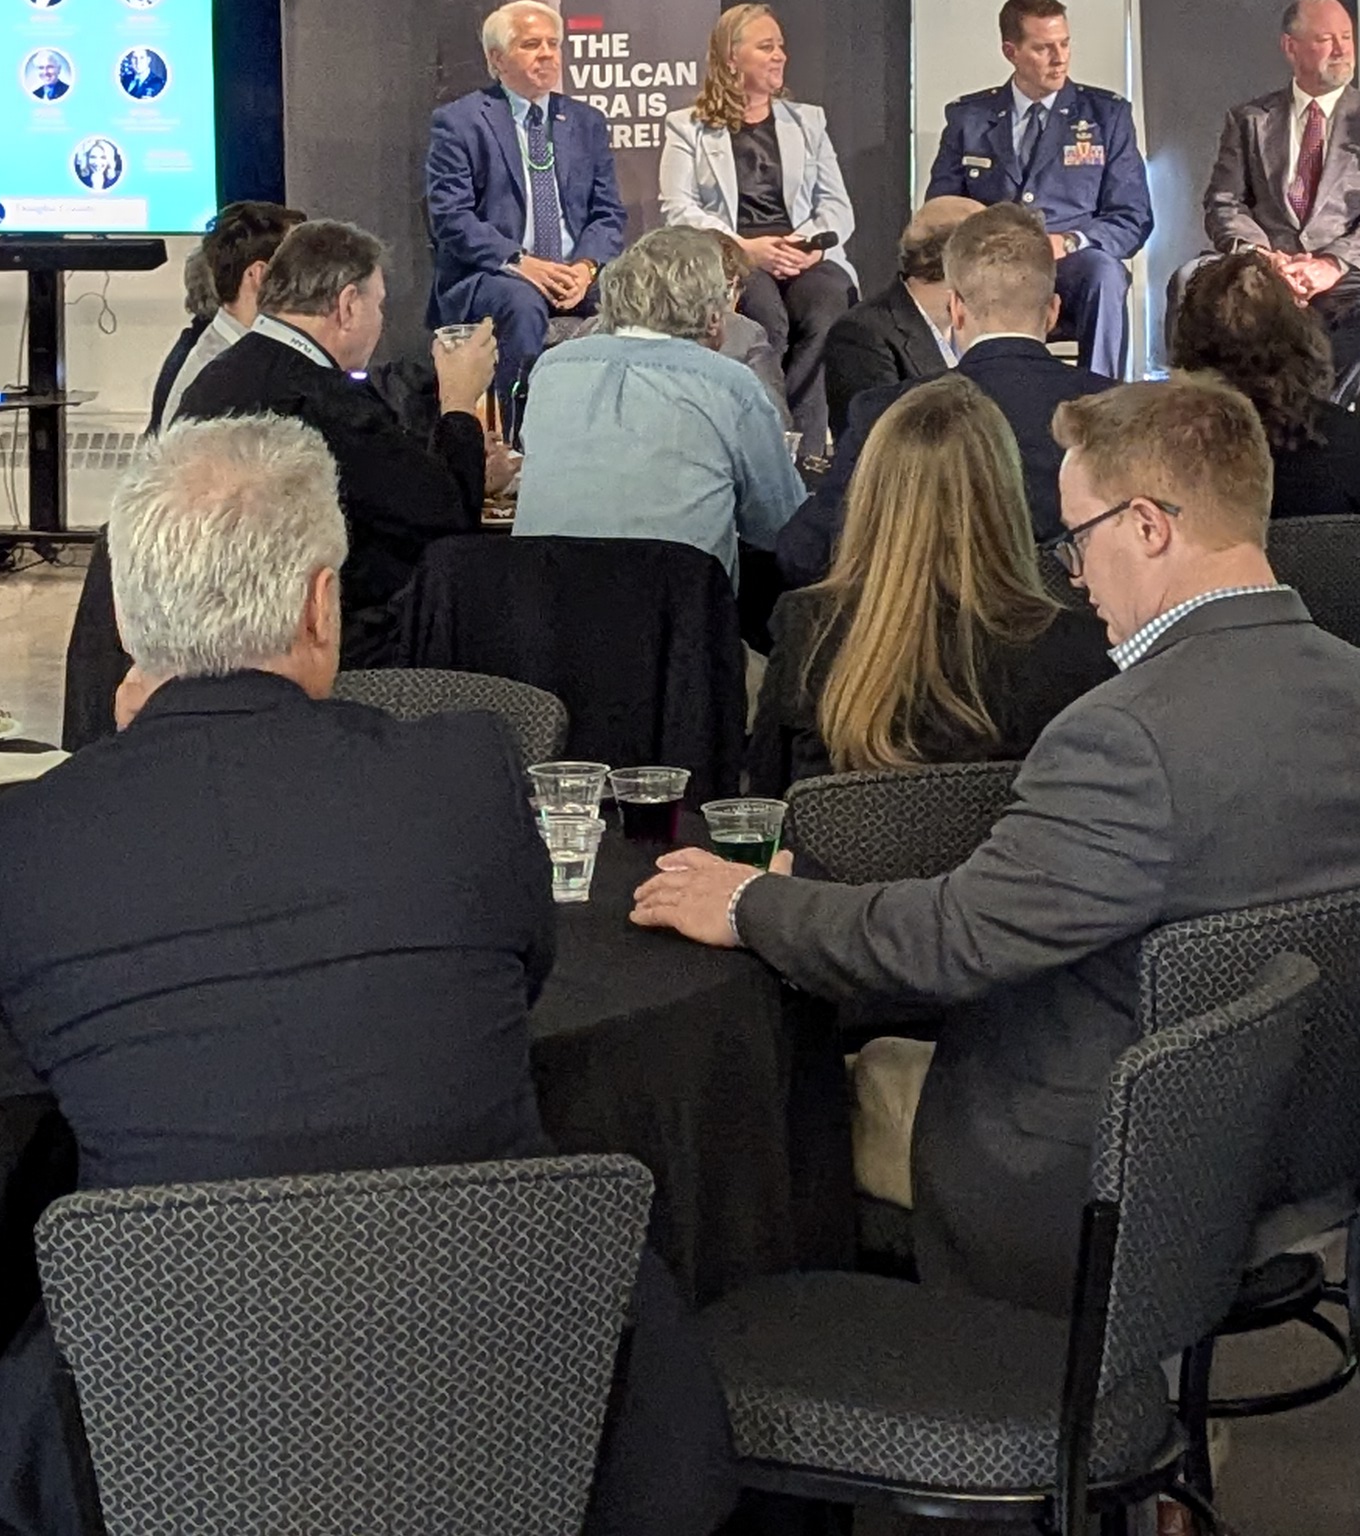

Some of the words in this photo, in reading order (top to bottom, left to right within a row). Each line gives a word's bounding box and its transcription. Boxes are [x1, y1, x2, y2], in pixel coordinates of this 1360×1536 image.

[568, 33, 630, 58] THE
[568, 61, 698, 89] VULCAN
[637, 93, 668, 117] IS
[607, 123, 661, 149] RE!
